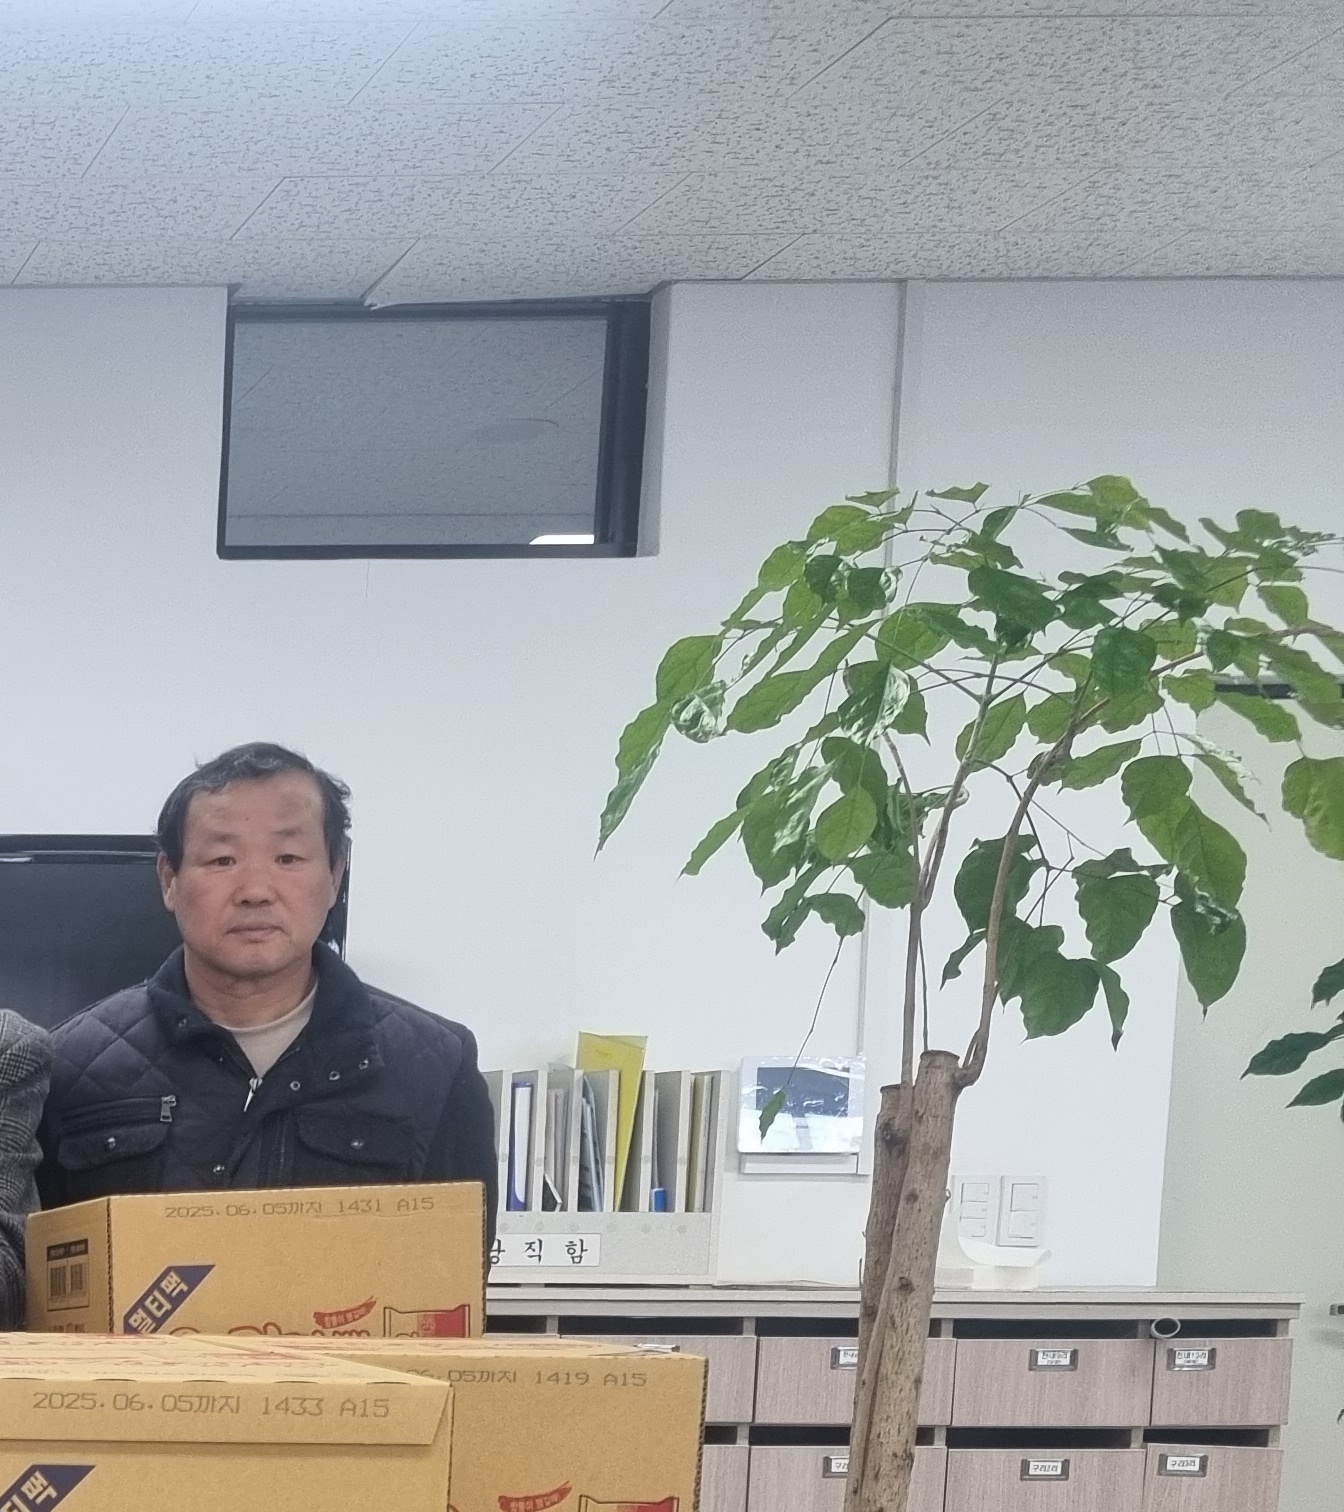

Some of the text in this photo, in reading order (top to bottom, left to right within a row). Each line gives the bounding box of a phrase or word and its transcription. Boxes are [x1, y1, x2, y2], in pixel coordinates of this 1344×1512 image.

[339, 1199, 381, 1213] 1431
[397, 1197, 435, 1211] A15
[262, 1396, 324, 1416] 1433
[340, 1398, 390, 1418] A15
